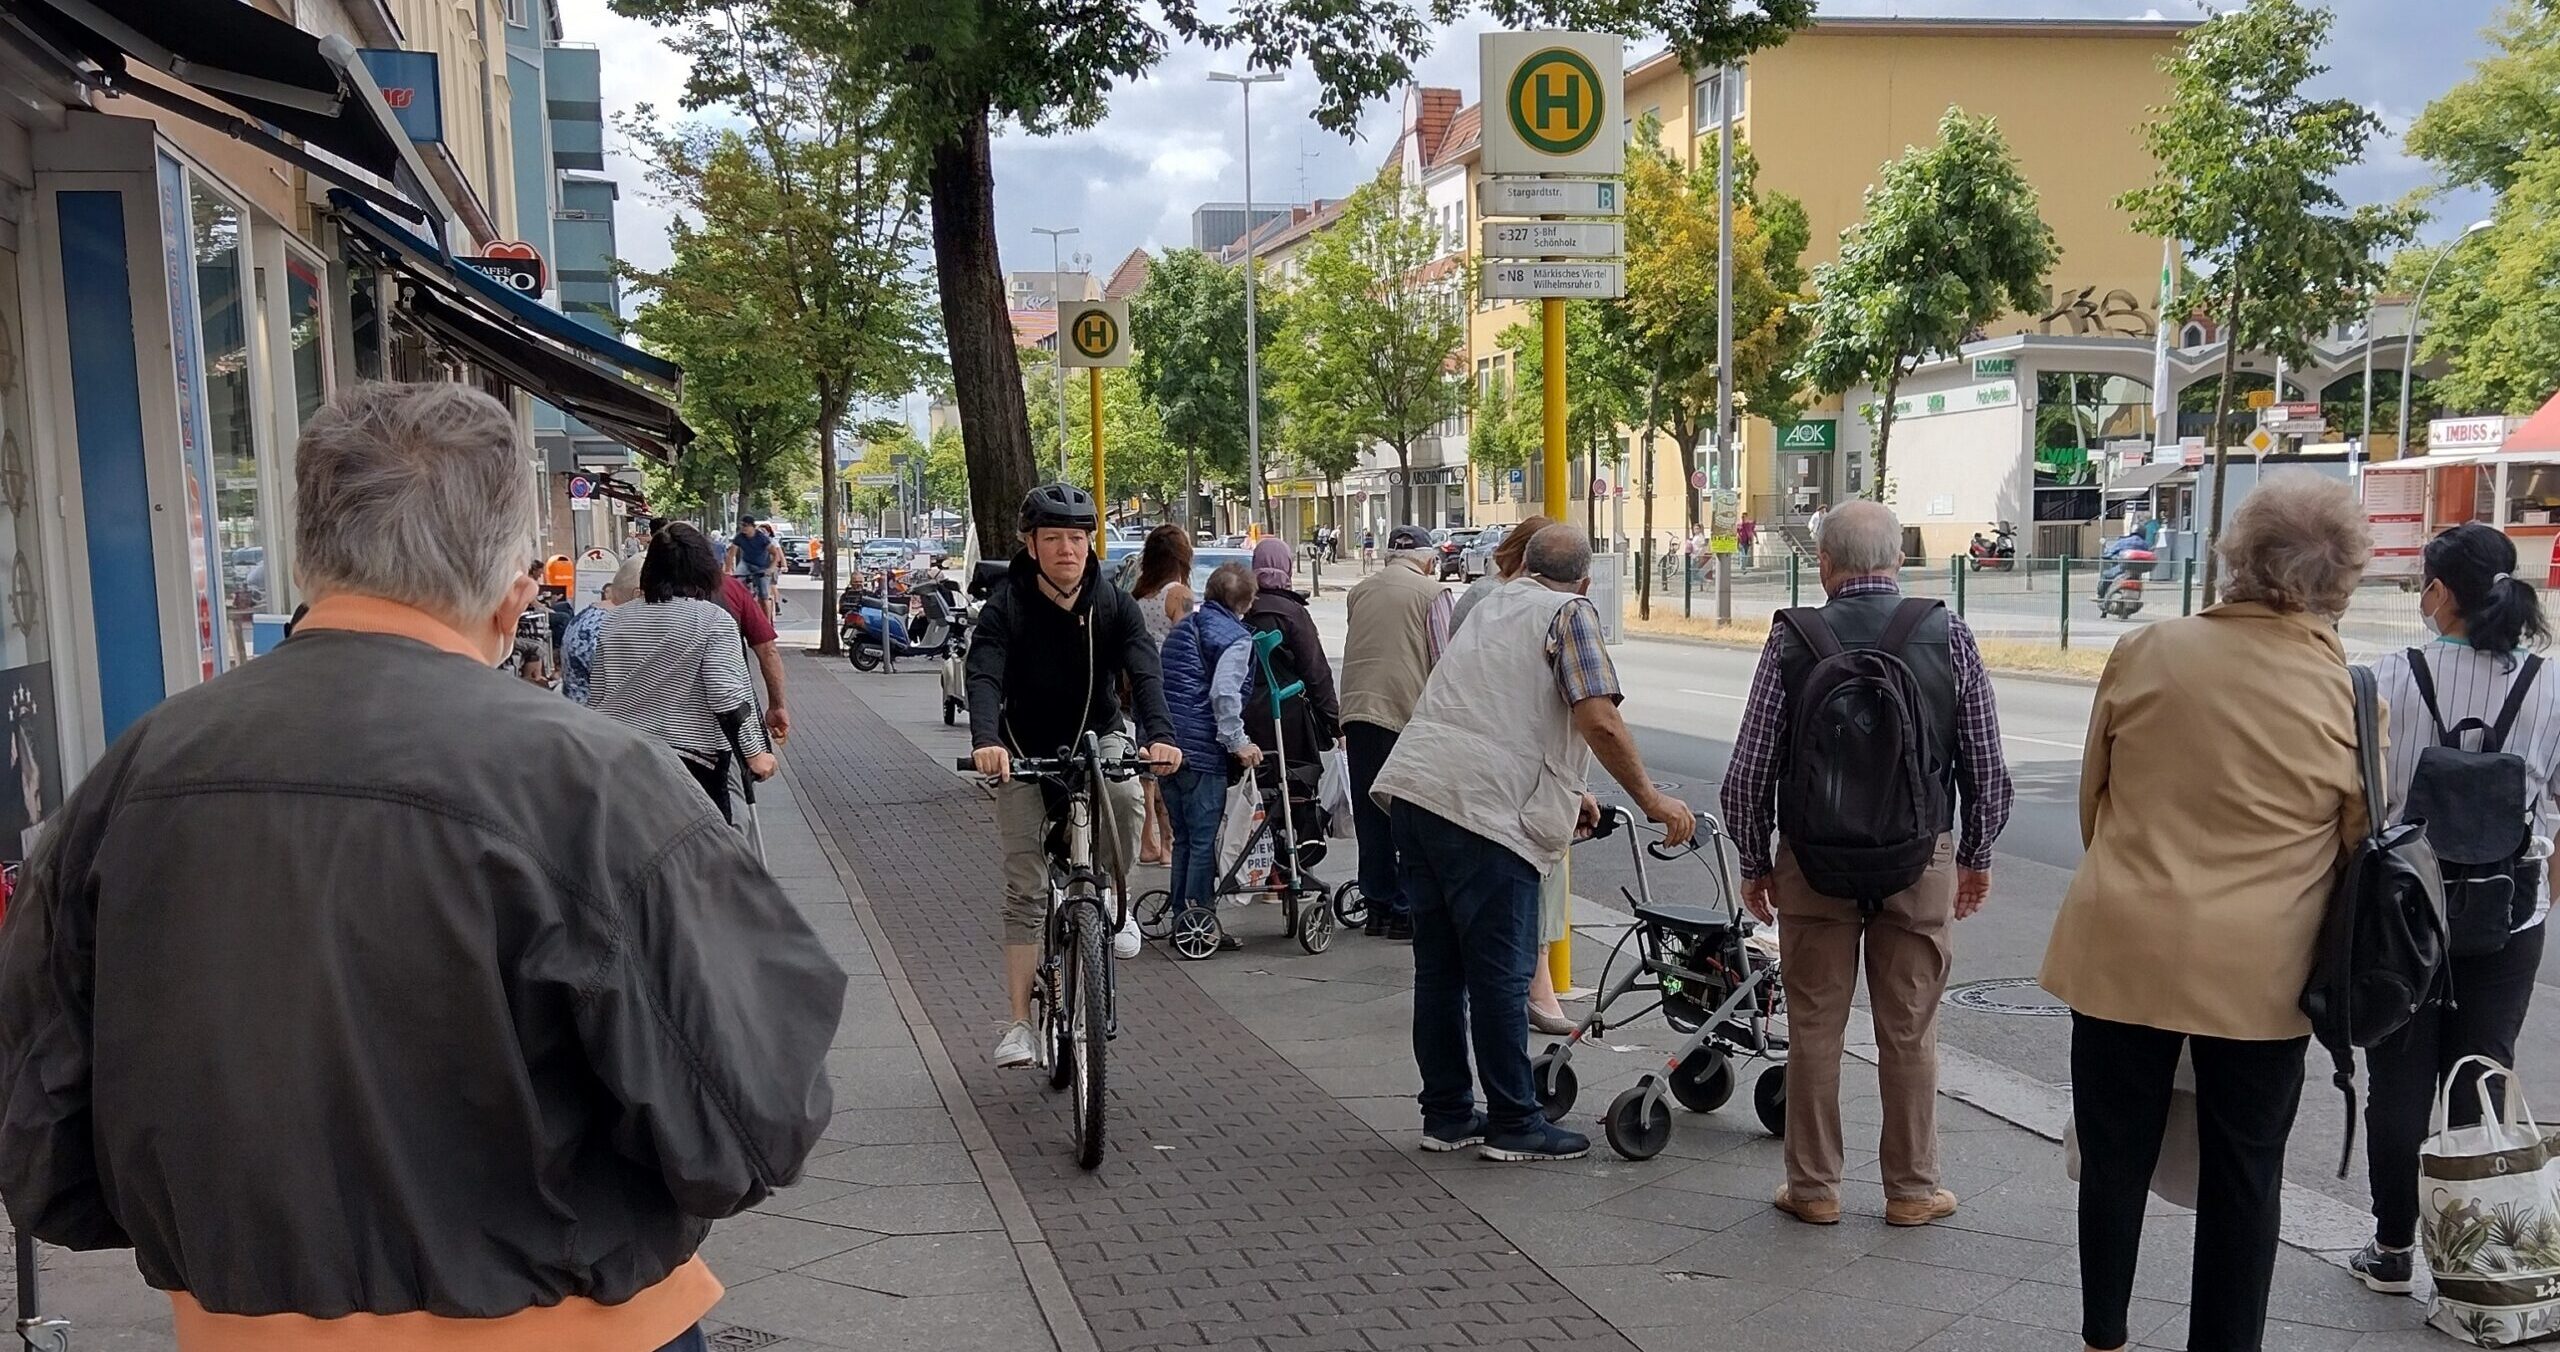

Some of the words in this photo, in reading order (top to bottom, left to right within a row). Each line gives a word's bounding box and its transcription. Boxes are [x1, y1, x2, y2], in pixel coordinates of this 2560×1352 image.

[1536, 74, 1579, 130] H
[1507, 187, 1562, 199] Stargardtstr.
[1601, 187, 1612, 208] B
[1507, 228, 1528, 241] 327
[1534, 227, 1557, 237] S-Bhf
[1534, 238, 1577, 248] Schönholz
[1507, 270, 1524, 282] N8
[1533, 269, 1580, 279] Märkisches
[1581, 269, 1607, 278] Viertel
[1533, 279, 1593, 290] Wilhelmsruher
[1084, 320, 1107, 347] H
[1786, 424, 1825, 442] AOK
[2446, 424, 2487, 442] IMBISS
